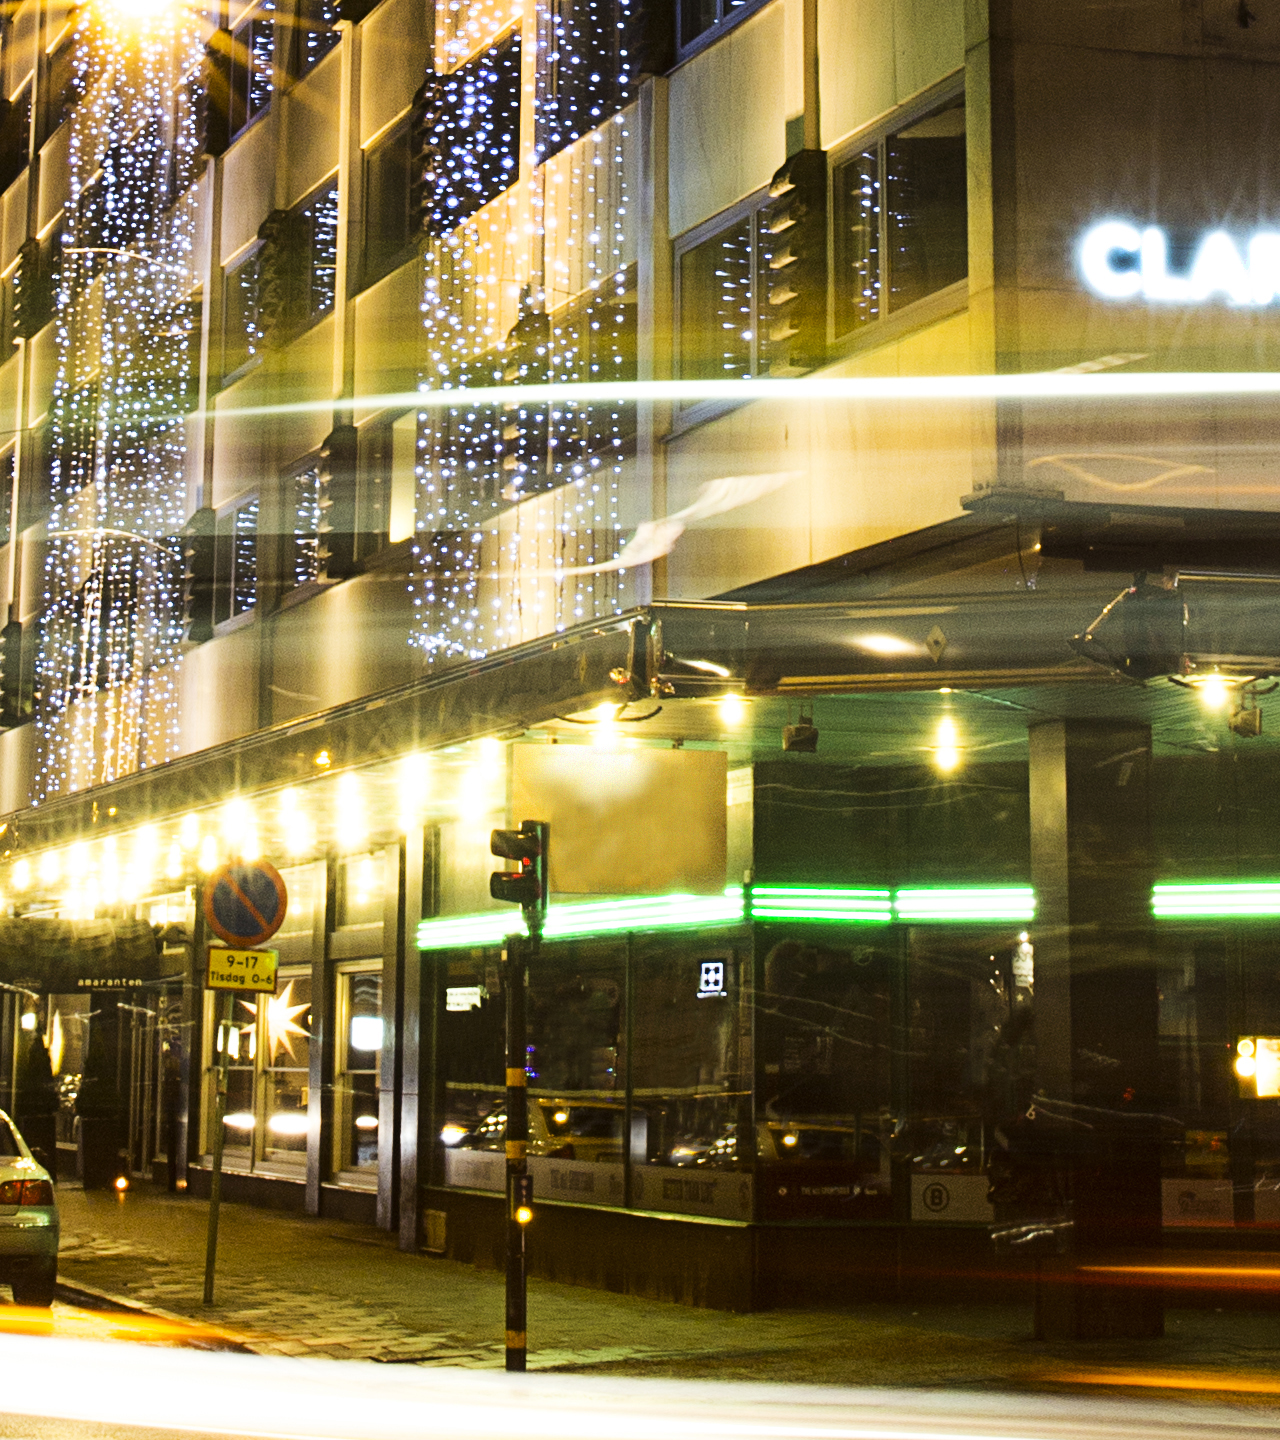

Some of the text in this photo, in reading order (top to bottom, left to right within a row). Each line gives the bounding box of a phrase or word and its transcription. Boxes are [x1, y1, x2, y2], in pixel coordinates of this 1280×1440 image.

[226, 955, 258, 969] 9-17
[77, 977, 143, 987] amaranten
[211, 971, 273, 985] Tisdag 0-6
